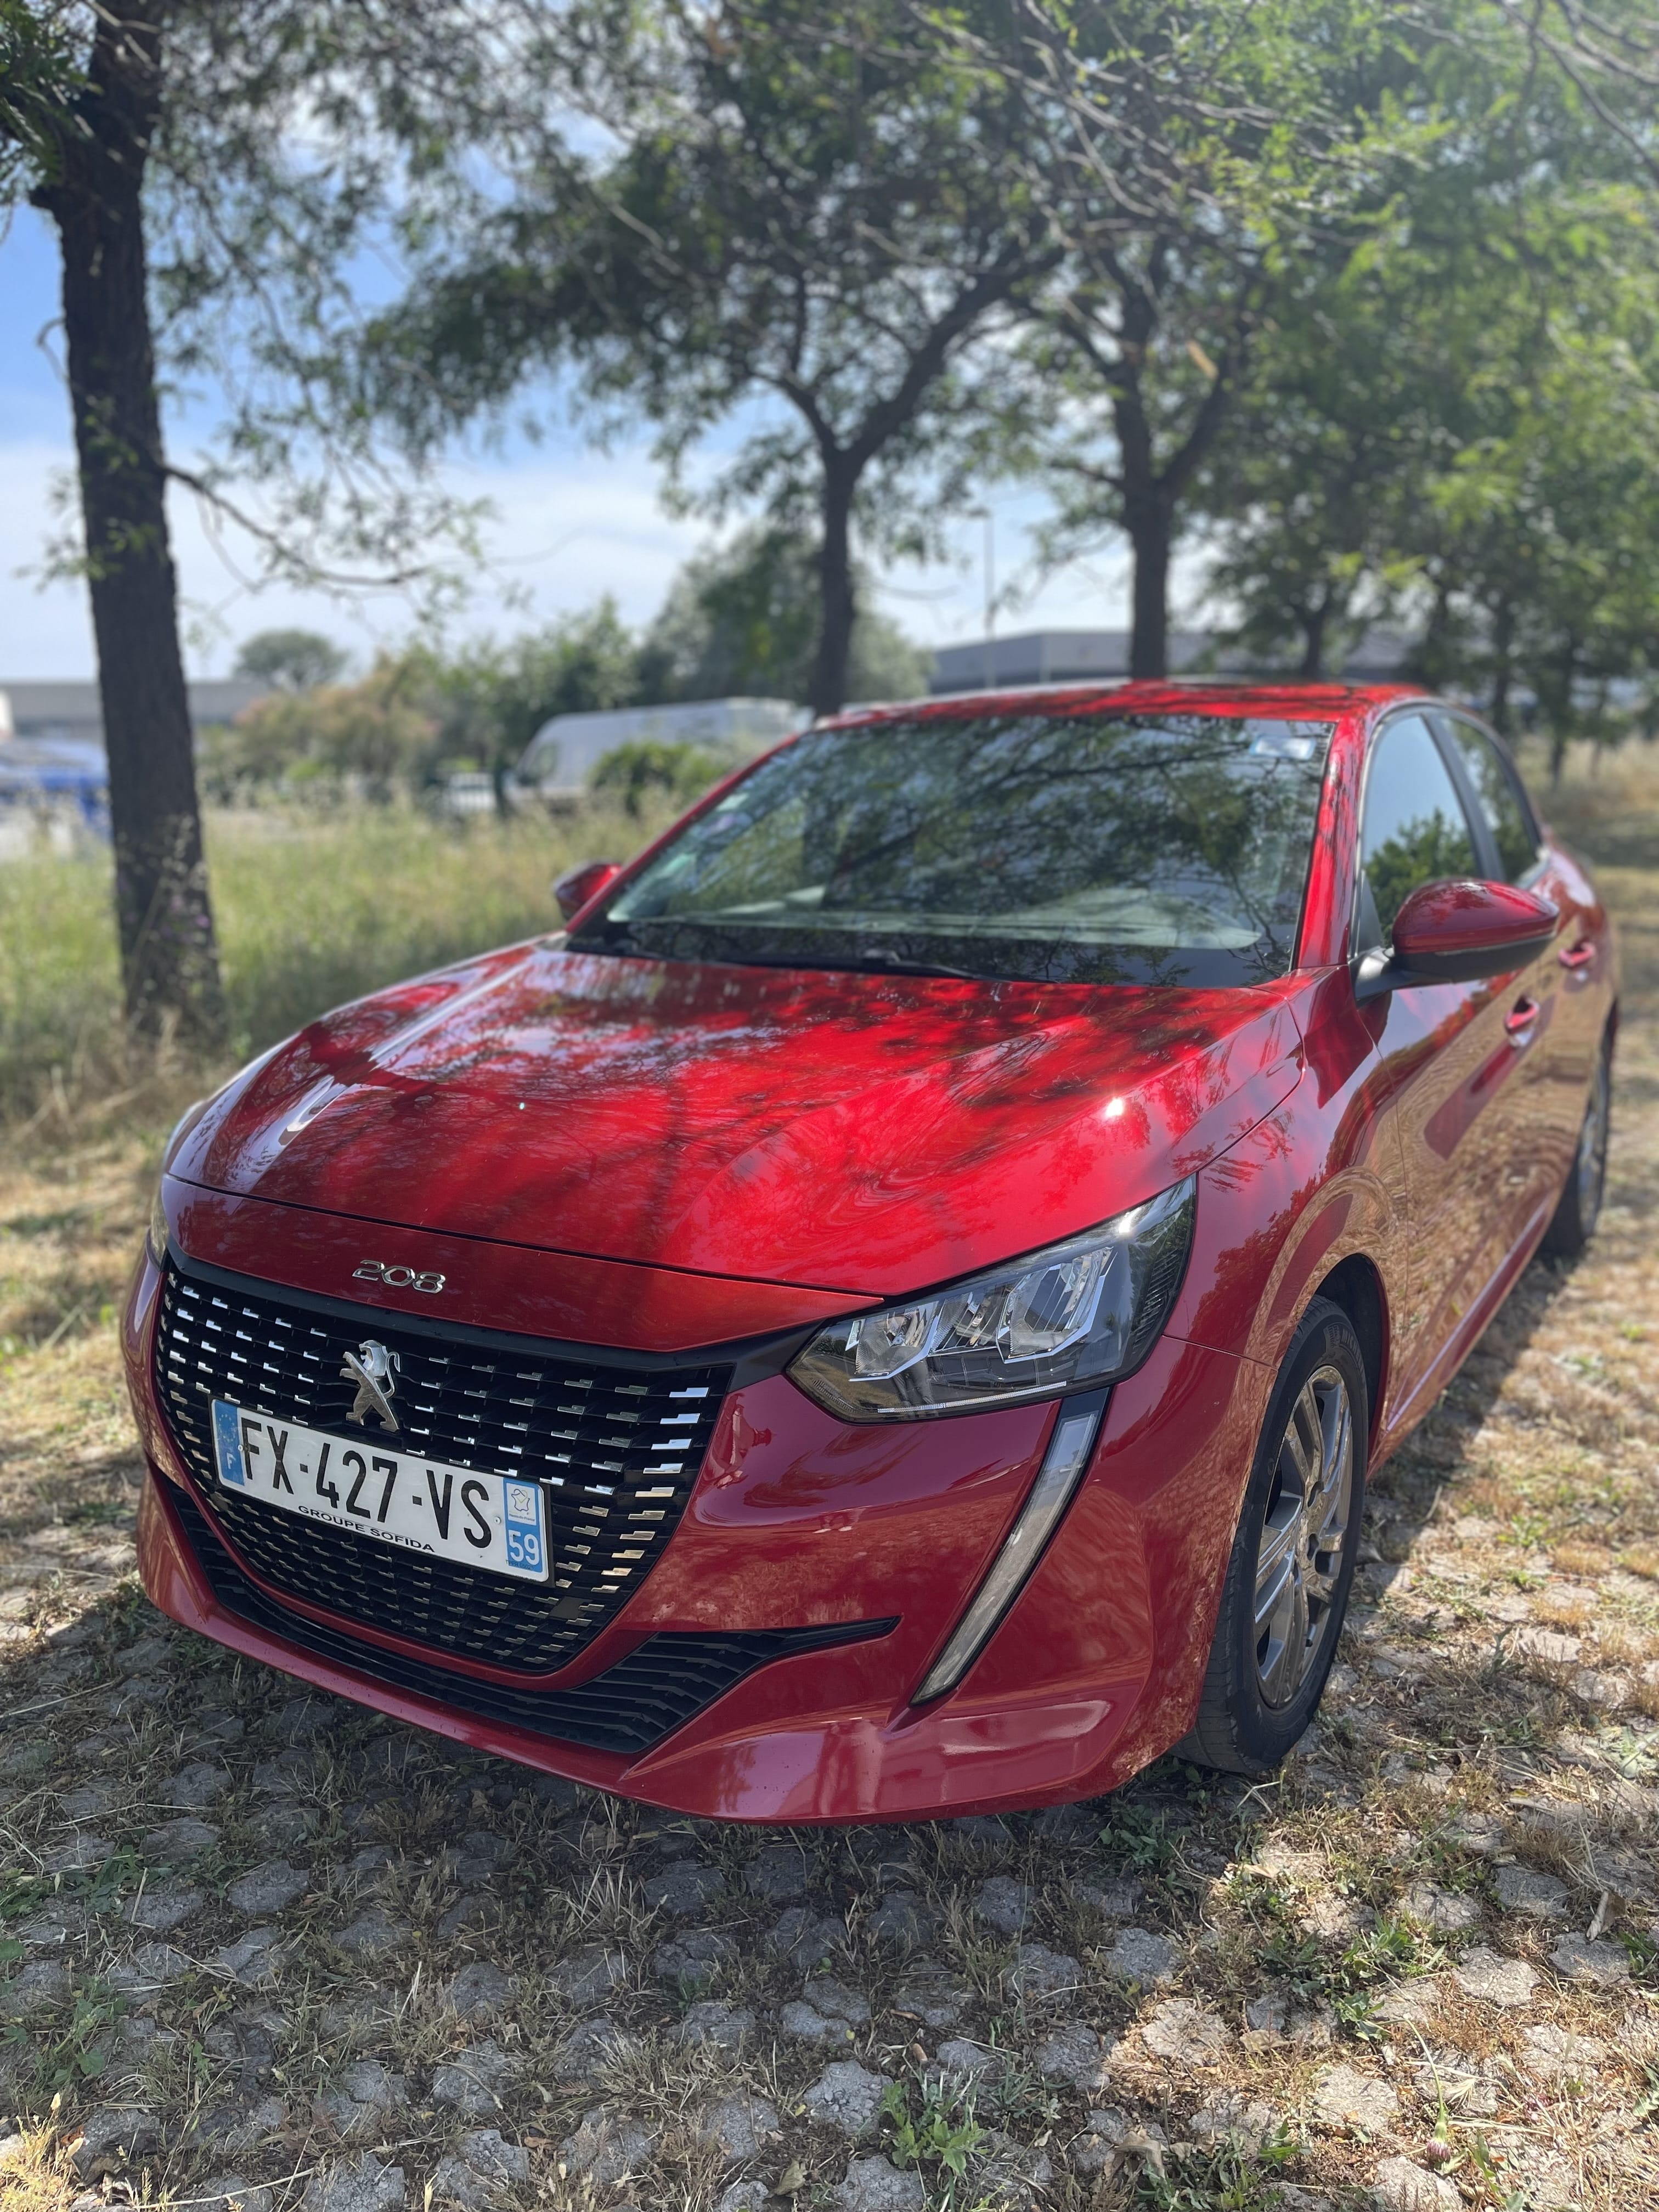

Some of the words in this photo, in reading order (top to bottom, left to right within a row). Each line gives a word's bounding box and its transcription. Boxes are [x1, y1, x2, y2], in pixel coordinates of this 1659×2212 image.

[352, 1259, 446, 1294] 208
[226, 1452, 236, 1470] F
[298, 1505, 366, 1533] GROUPE
[370, 1527, 435, 1553] SOFIDA
[508, 1529, 540, 1565] 59
